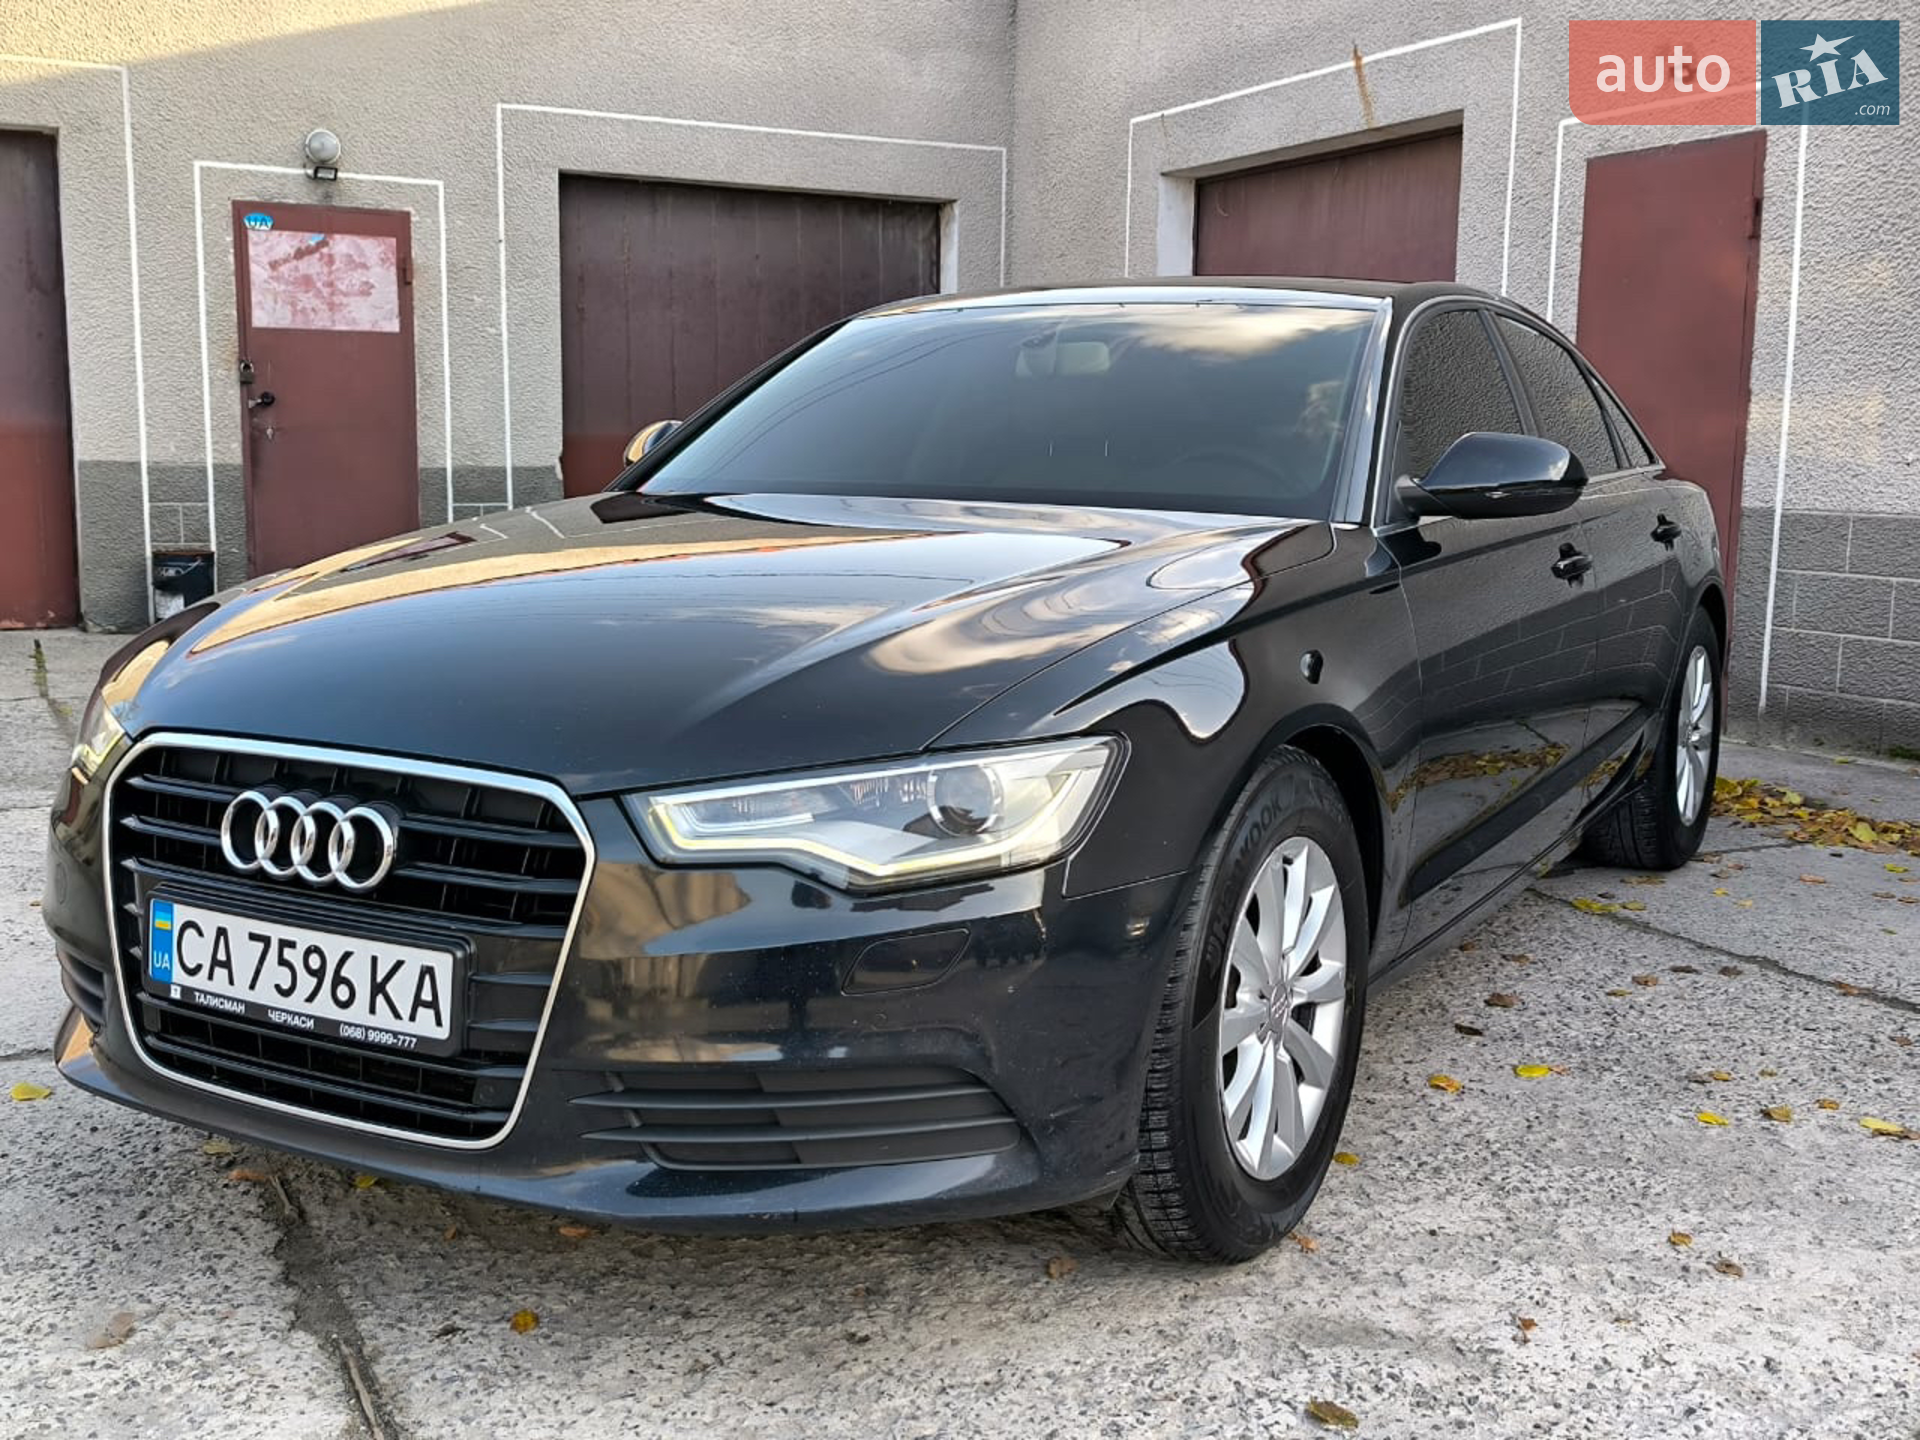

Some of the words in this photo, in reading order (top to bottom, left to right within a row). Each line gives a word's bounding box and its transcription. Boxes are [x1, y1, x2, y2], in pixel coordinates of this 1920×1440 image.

[153, 950, 170, 970] UA
[248, 931, 358, 1009] 7596
[193, 991, 245, 1014] ТАЛИСМАН
[267, 1009, 314, 1029] ЧЕРКАСИ
